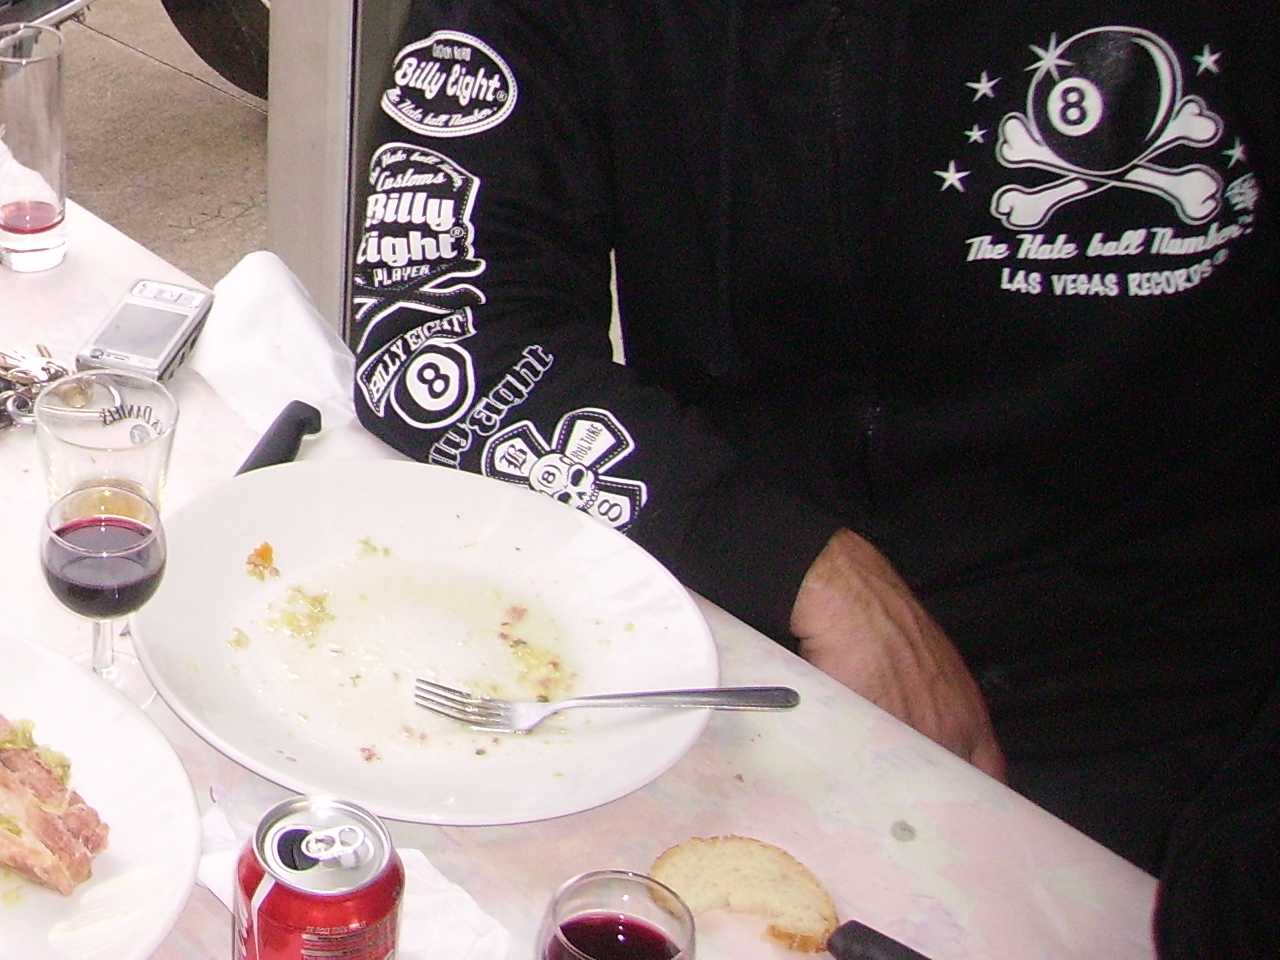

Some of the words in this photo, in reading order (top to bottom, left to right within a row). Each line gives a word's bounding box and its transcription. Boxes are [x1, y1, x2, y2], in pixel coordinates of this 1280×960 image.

[393, 56, 447, 100] Billy
[445, 63, 502, 107] Eight
[1060, 86, 1087, 126] 8
[375, 168, 448, 192] Customs
[365, 191, 456, 232] Billy
[965, 234, 1010, 262] The
[1085, 227, 1149, 257] ball
[372, 264, 431, 288] PLAYER
[1000, 266, 1043, 295] LAS
[1050, 272, 1120, 296] VEGAS
[369, 338, 407, 402] BILLY
[403, 313, 464, 352] EIGHT
[416, 362, 451, 400] 8
